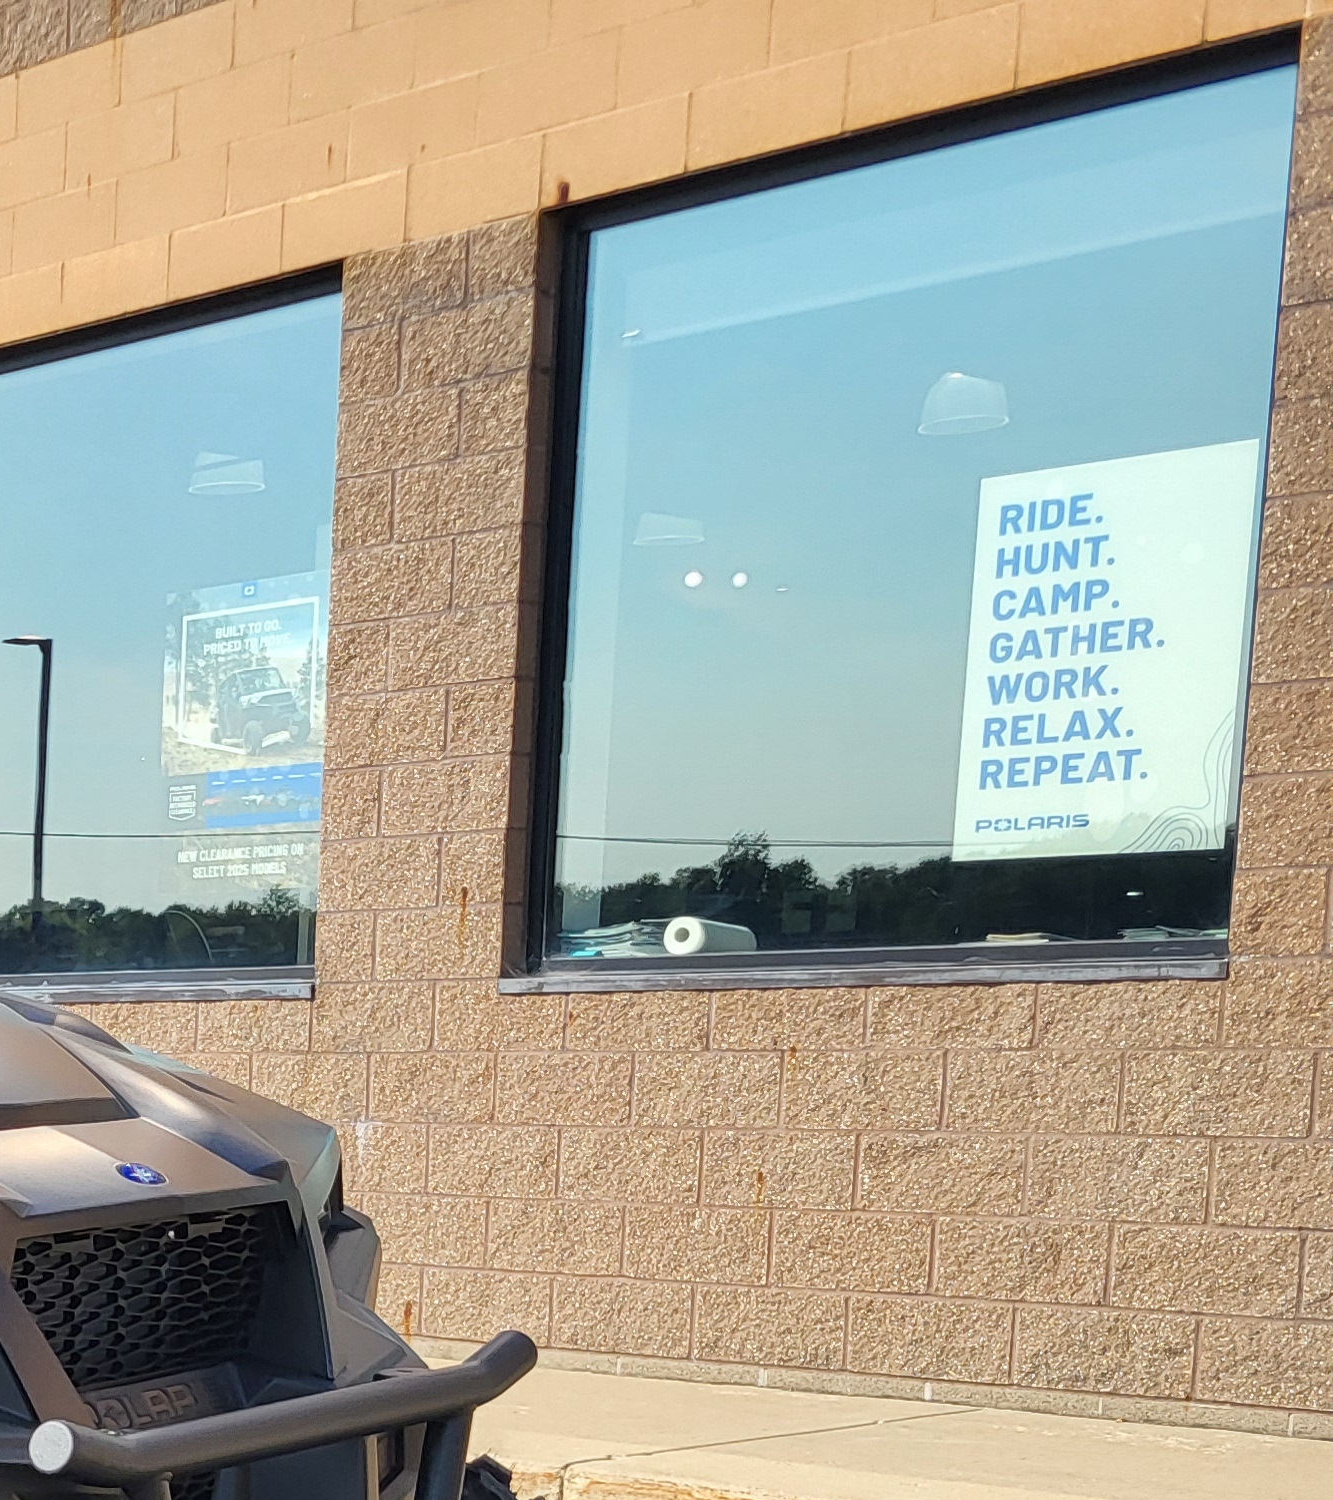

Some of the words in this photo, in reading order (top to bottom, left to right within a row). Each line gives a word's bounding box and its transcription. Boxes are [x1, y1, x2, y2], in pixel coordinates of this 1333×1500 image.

[999, 493, 1103, 536] RIDE.
[995, 535, 1115, 579] HUNT.
[992, 579, 1119, 621] CAMP.
[203, 640, 242, 656] PRICED
[216, 624, 246, 639] BUILT
[248, 621, 262, 634] TO
[989, 618, 1165, 663] GATHER.
[987, 665, 1119, 705] WORK.
[982, 707, 1134, 748] RELAX.
[979, 749, 1148, 790] REPEAT.
[975, 814, 1090, 833] POLARIS
[177, 850, 199, 863] NEW
[199, 846, 252, 862] CLEARANCE
[253, 844, 290, 858] PRICING
[290, 842, 305, 855] ON
[193, 865, 226, 878] SELECT
[251, 861, 287, 875] MODELS
